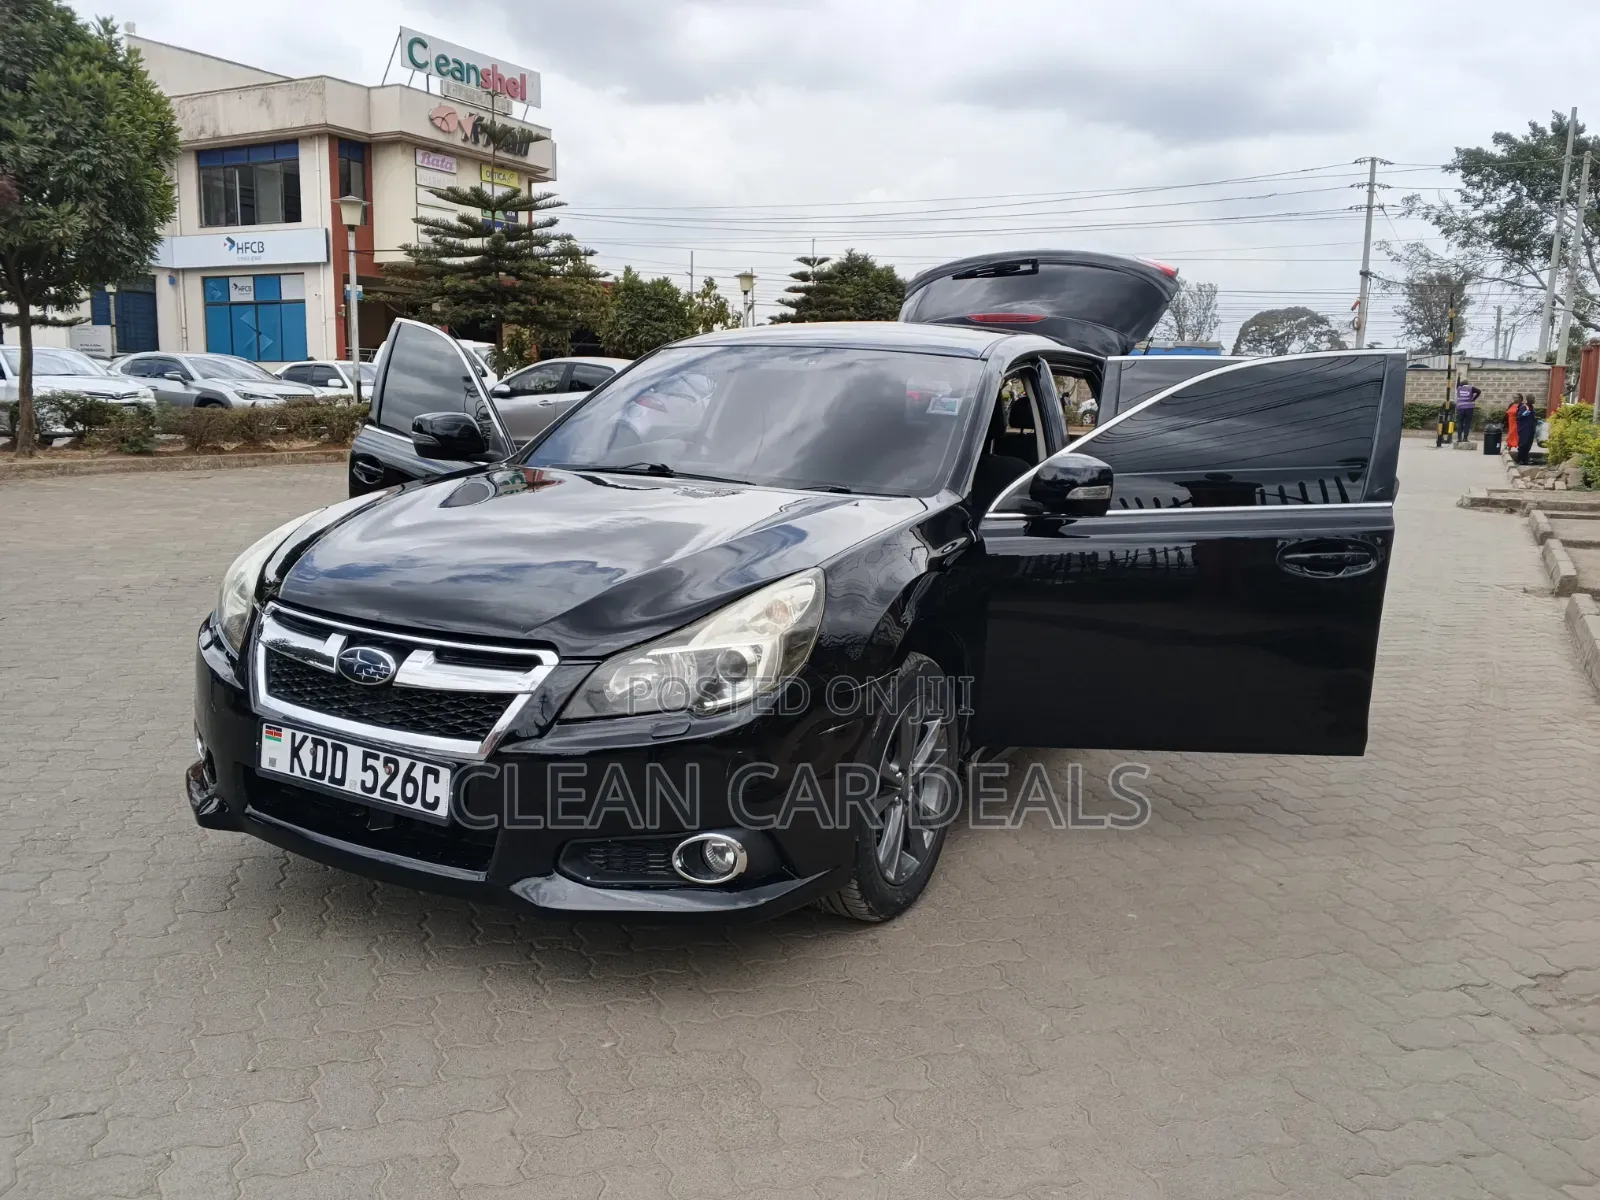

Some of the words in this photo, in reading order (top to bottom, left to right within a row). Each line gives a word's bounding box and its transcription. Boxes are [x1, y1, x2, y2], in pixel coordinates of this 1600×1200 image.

[407, 36, 527, 101] Ceanshel
[420, 151, 454, 171] Bata
[236, 241, 265, 254] HFCB
[289, 731, 348, 787] KDD
[360, 749, 441, 812] 526C
